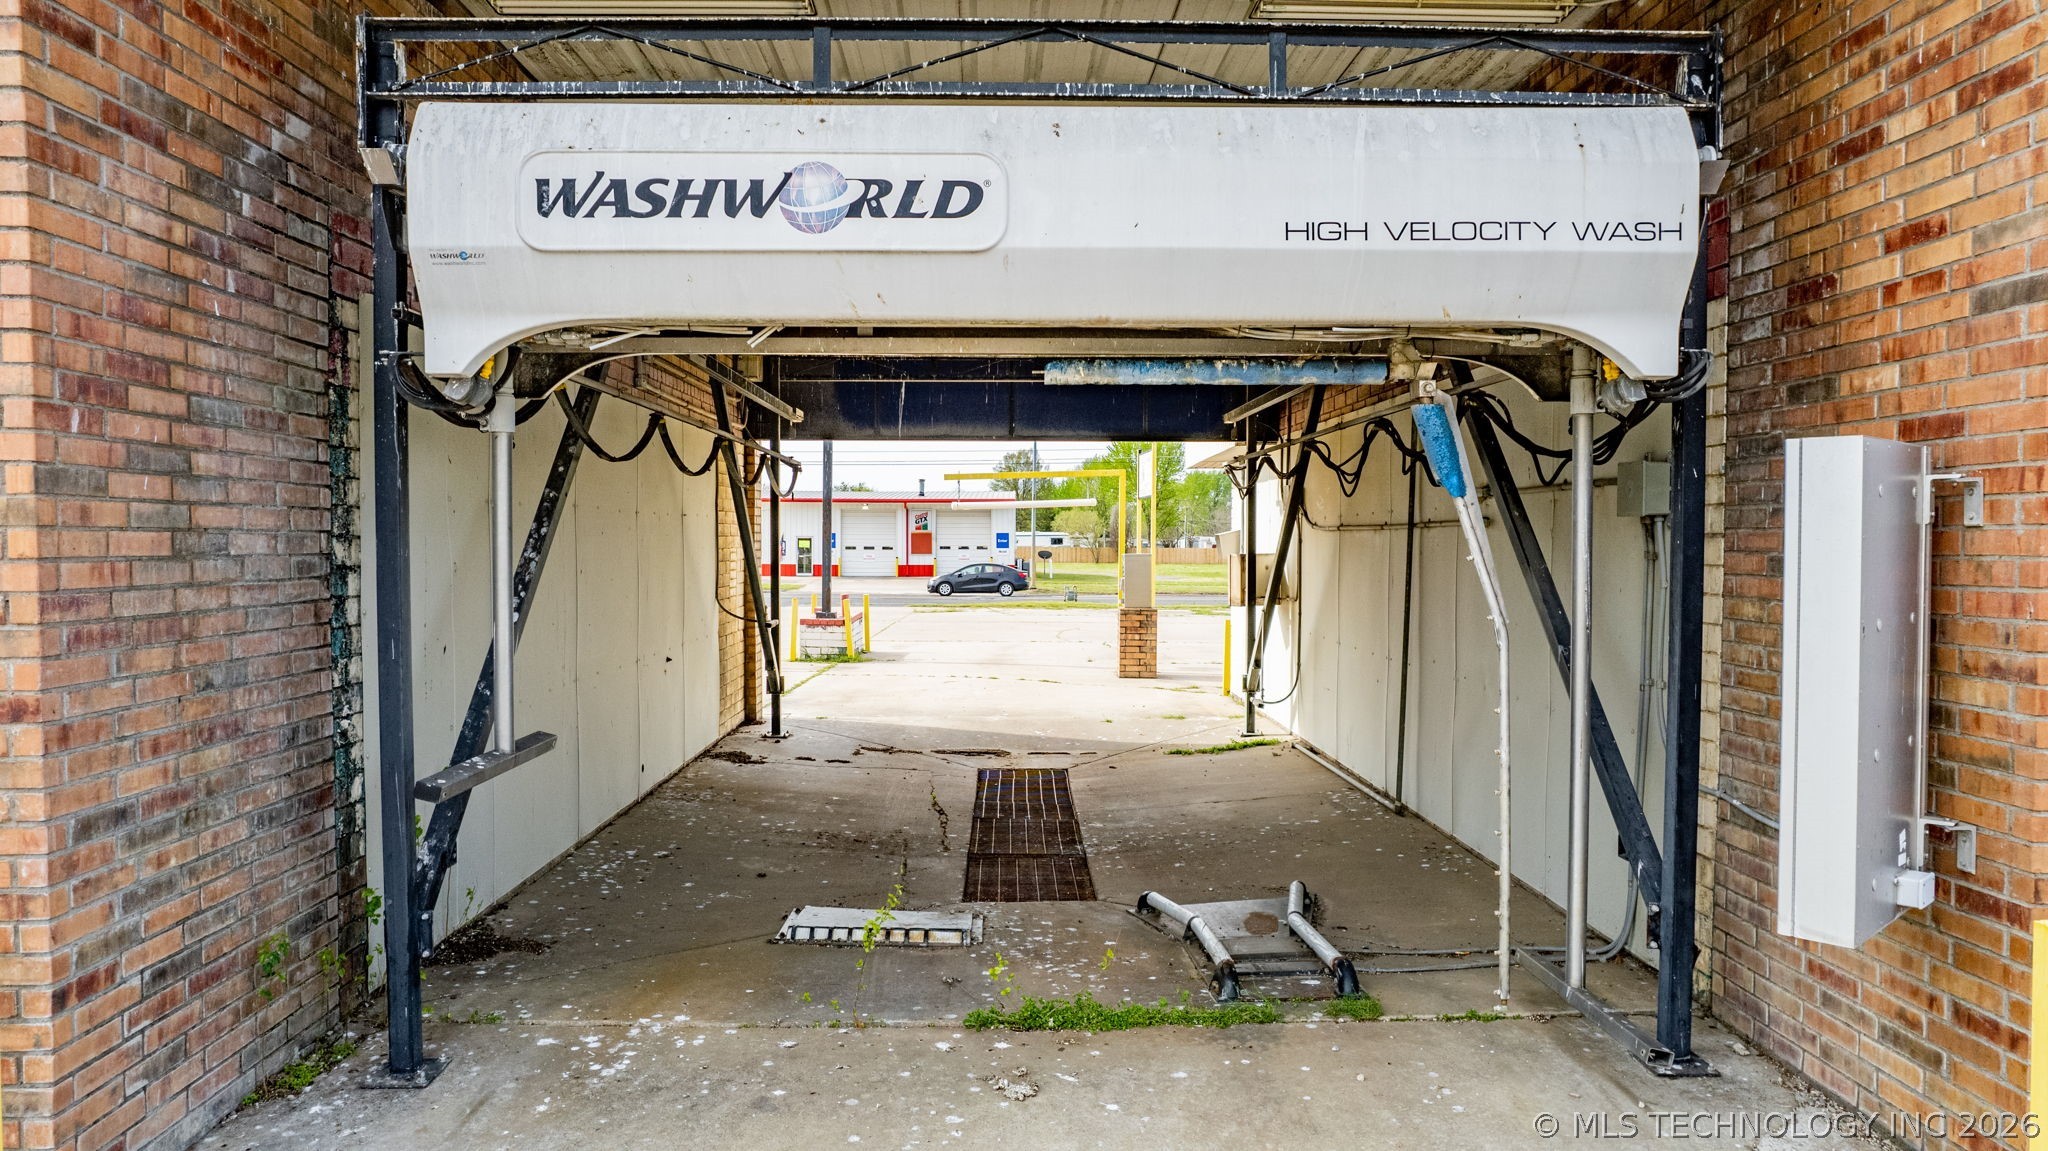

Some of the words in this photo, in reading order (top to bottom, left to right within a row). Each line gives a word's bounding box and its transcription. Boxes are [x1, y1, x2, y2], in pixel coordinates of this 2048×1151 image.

[1285, 221, 1369, 242] HIGH
[1383, 221, 1557, 242] VELOCITY
[1571, 221, 1683, 242] WASH
[915, 516, 928, 524] GTX
